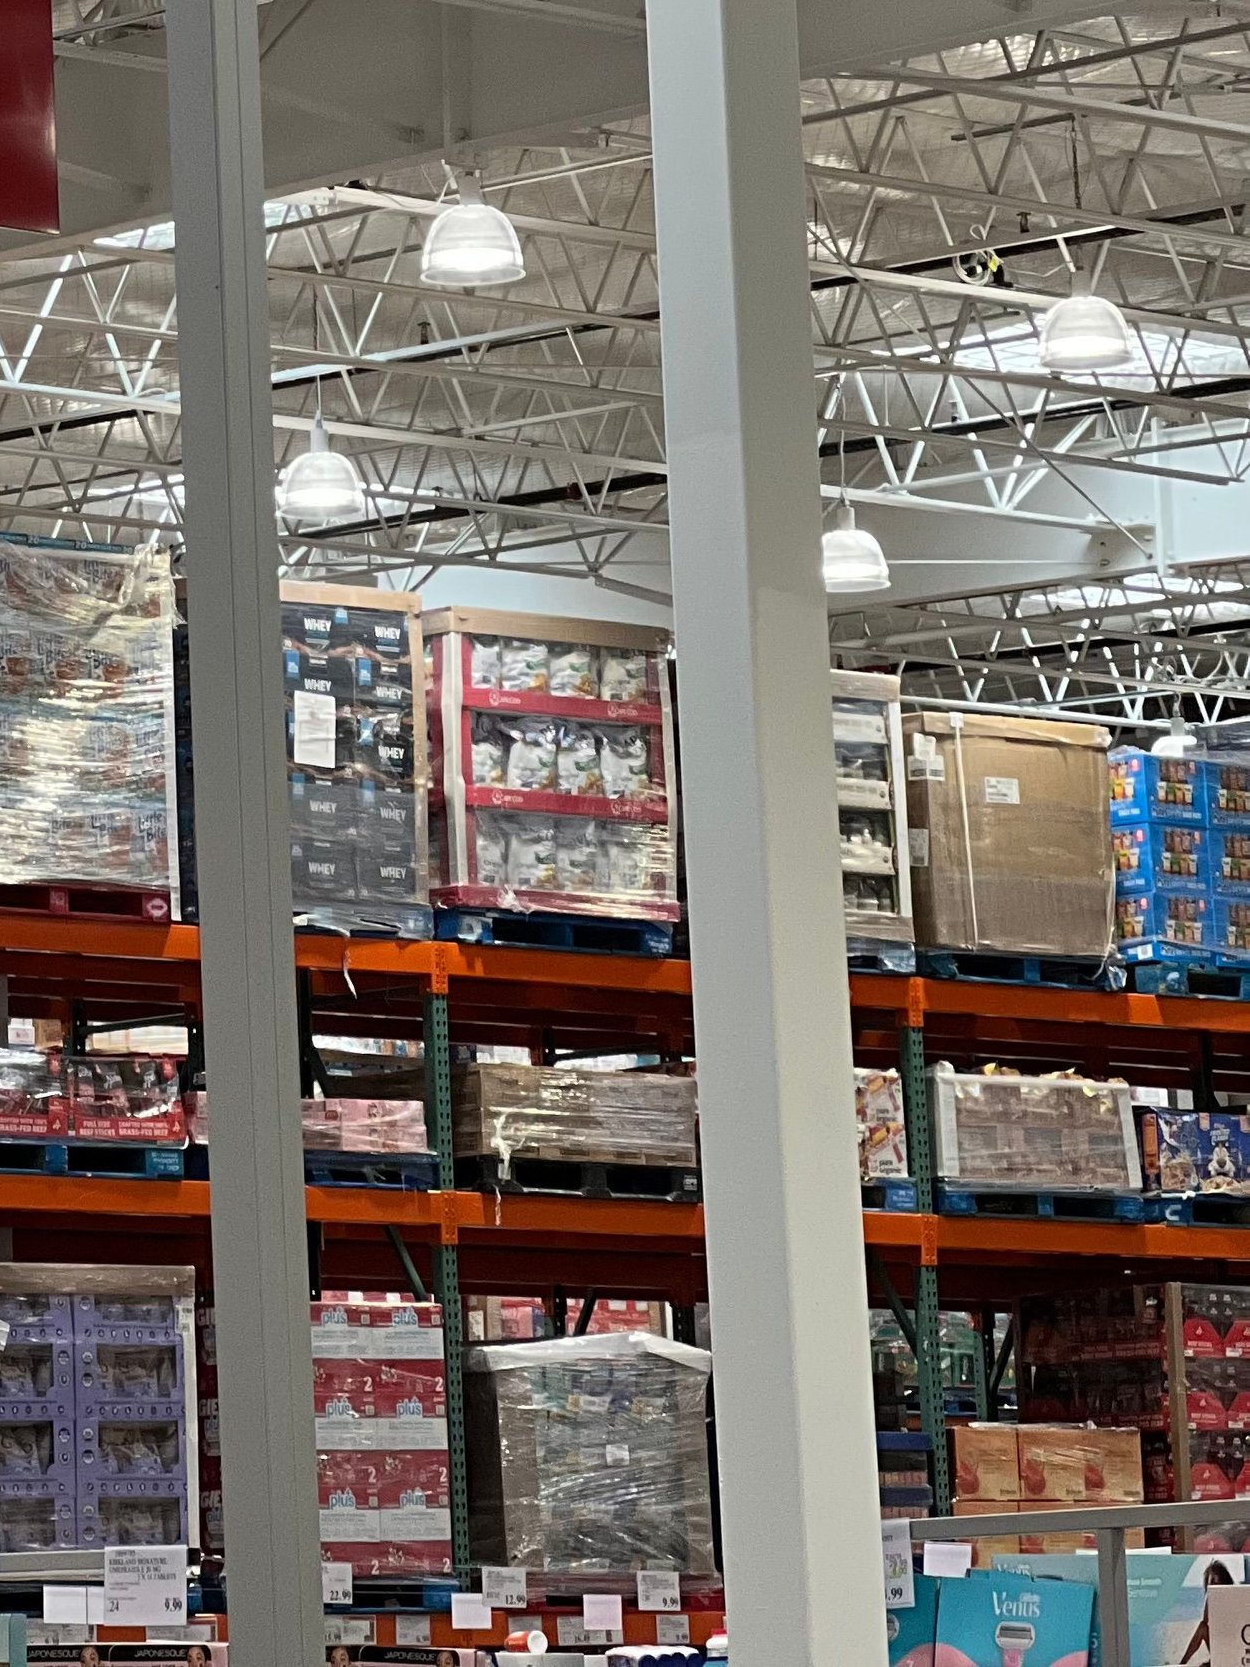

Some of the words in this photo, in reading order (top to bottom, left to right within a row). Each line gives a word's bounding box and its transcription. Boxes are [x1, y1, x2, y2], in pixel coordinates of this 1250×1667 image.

[304, 618, 331, 632] WHEY
[375, 626, 400, 639] WHEY
[304, 678, 331, 692] WHEY
[376, 686, 402, 699] WHEY
[378, 745, 405, 760] WHEY
[309, 800, 337, 813] WHEY
[380, 807, 407, 821] WHEY
[308, 862, 336, 875] WHEY
[380, 867, 407, 879] WHEY
[323, 1308, 347, 1324] plus
[364, 1377, 373, 1391] 2
[435, 1377, 444, 1391] 2
[398, 1400, 422, 1416] plus
[439, 1467, 448, 1482] 2
[331, 1490, 355, 1507] plus
[443, 1558, 451, 1573] 2
[329, 1590, 351, 1601] 22.99
[505, 1594, 526, 1605] 12.99
[662, 1597, 679, 1608] 9.99
[164, 1597, 182, 1613] 9.99
[992, 1590, 1040, 1617] Venus
[27, 1648, 79, 1658] JAPONESQUE
[135, 1648, 187, 1658] JAPONESQUE
[384, 1651, 435, 1661] JAPONESQUE
